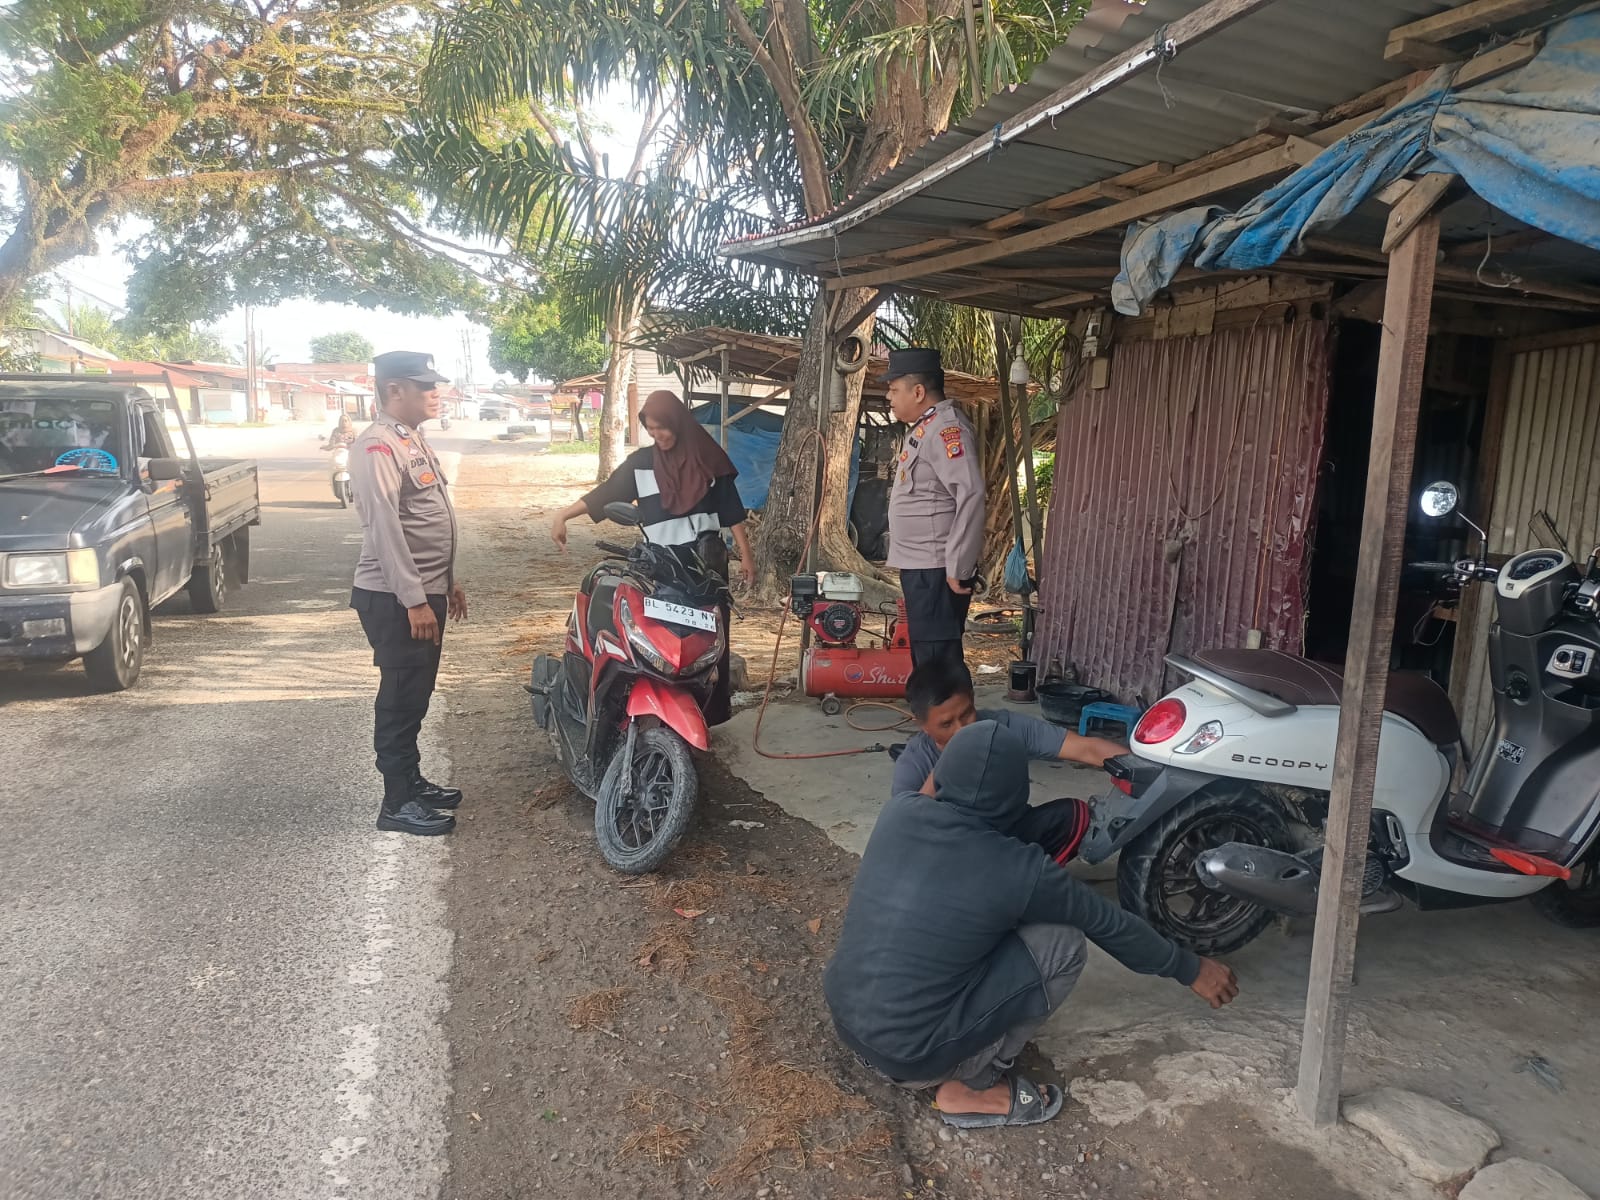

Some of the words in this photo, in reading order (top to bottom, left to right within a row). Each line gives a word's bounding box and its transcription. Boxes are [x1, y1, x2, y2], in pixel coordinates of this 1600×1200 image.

[645, 599, 658, 608] BL
[665, 603, 694, 616] 5423
[702, 612, 715, 622] NY
[1231, 753, 1328, 771] SCOOPY
